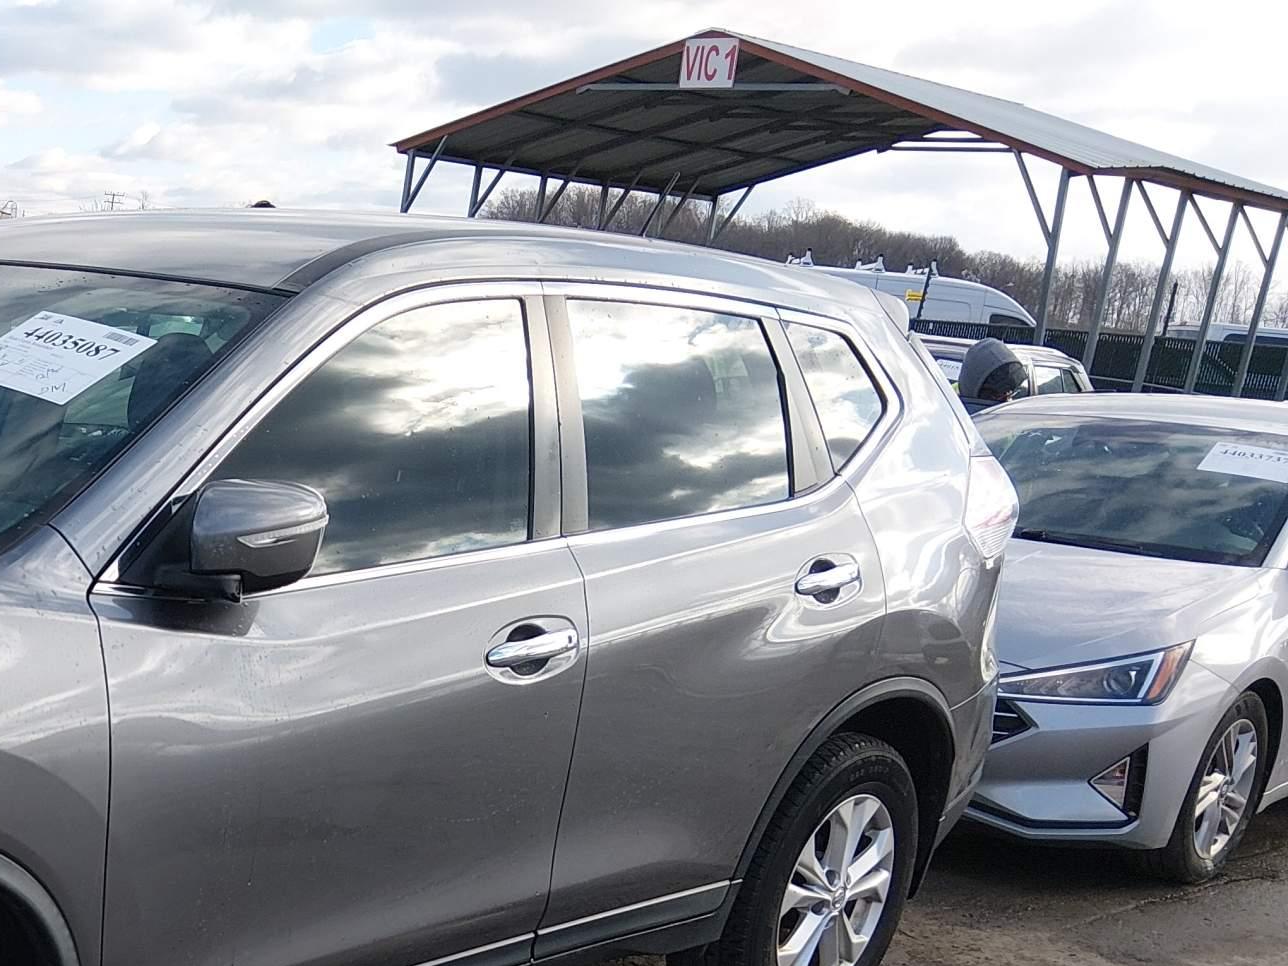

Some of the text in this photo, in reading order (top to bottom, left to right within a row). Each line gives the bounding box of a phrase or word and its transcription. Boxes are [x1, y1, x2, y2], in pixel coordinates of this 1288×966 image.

[686, 44, 737, 81] VIC 1
[23, 326, 121, 361] 44035087
